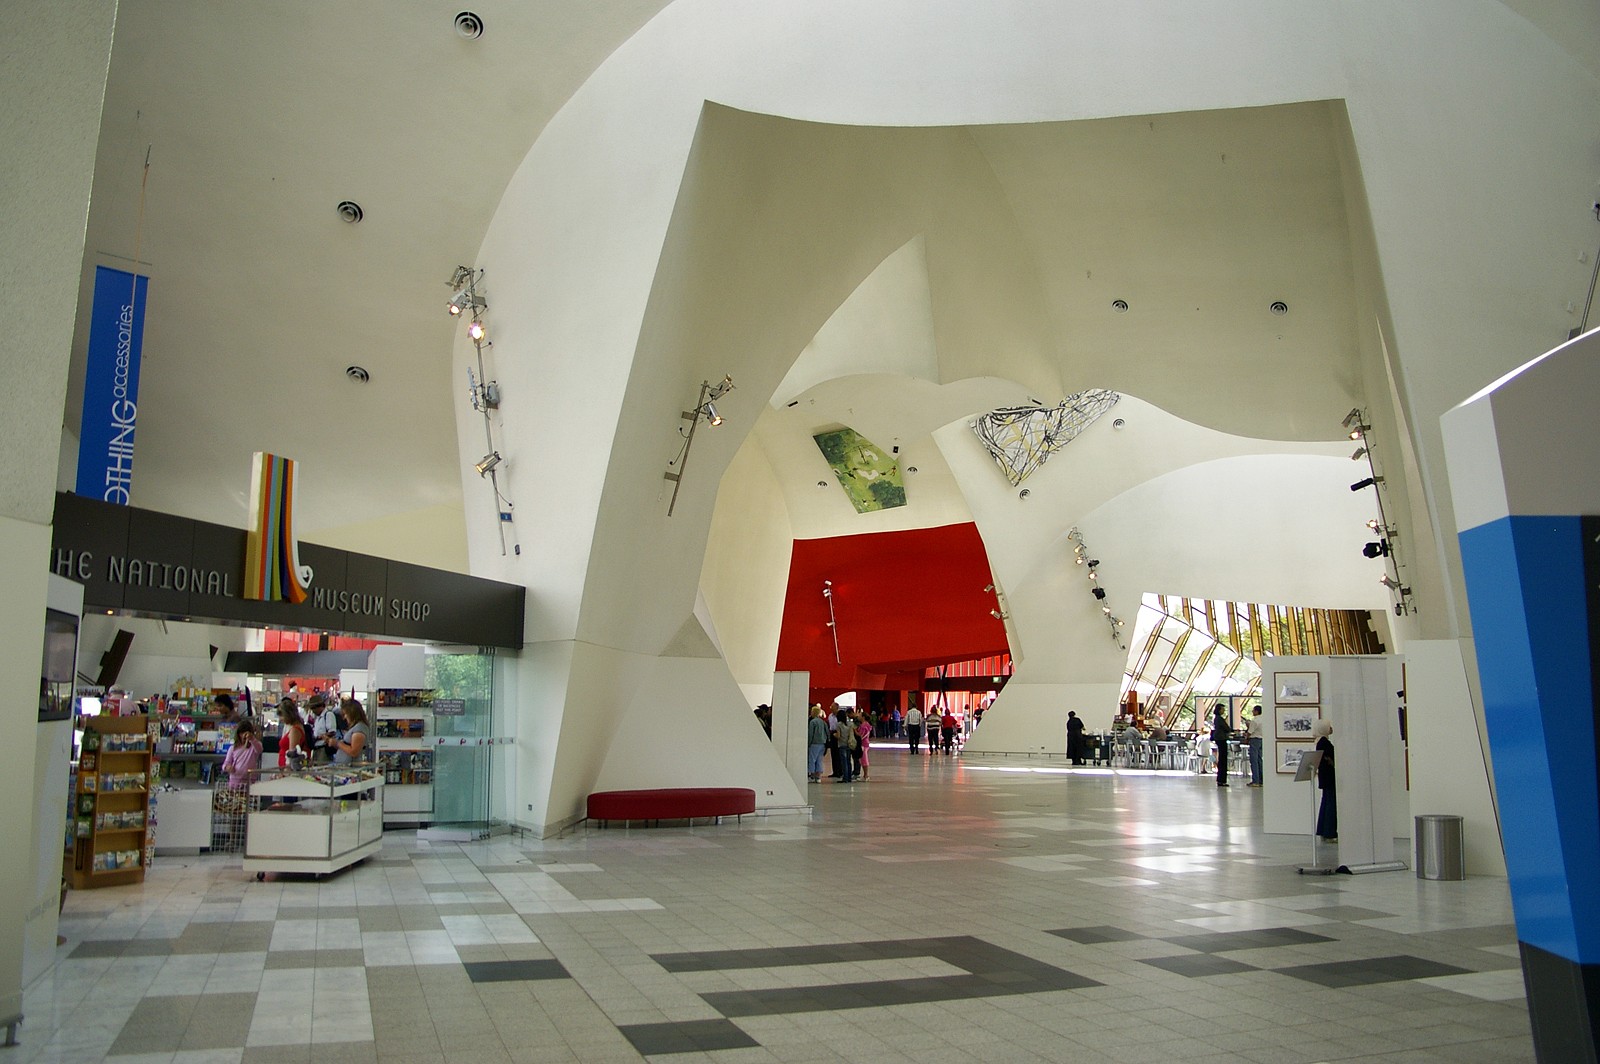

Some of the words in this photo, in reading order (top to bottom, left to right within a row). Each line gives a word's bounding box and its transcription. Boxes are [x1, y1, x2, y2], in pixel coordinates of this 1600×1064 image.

[113, 304, 132, 399] accessories
[52, 547, 93, 579] HE
[109, 555, 234, 598] NATIONAL
[313, 586, 384, 616] MUSEUM
[391, 598, 431, 622] SHOP
